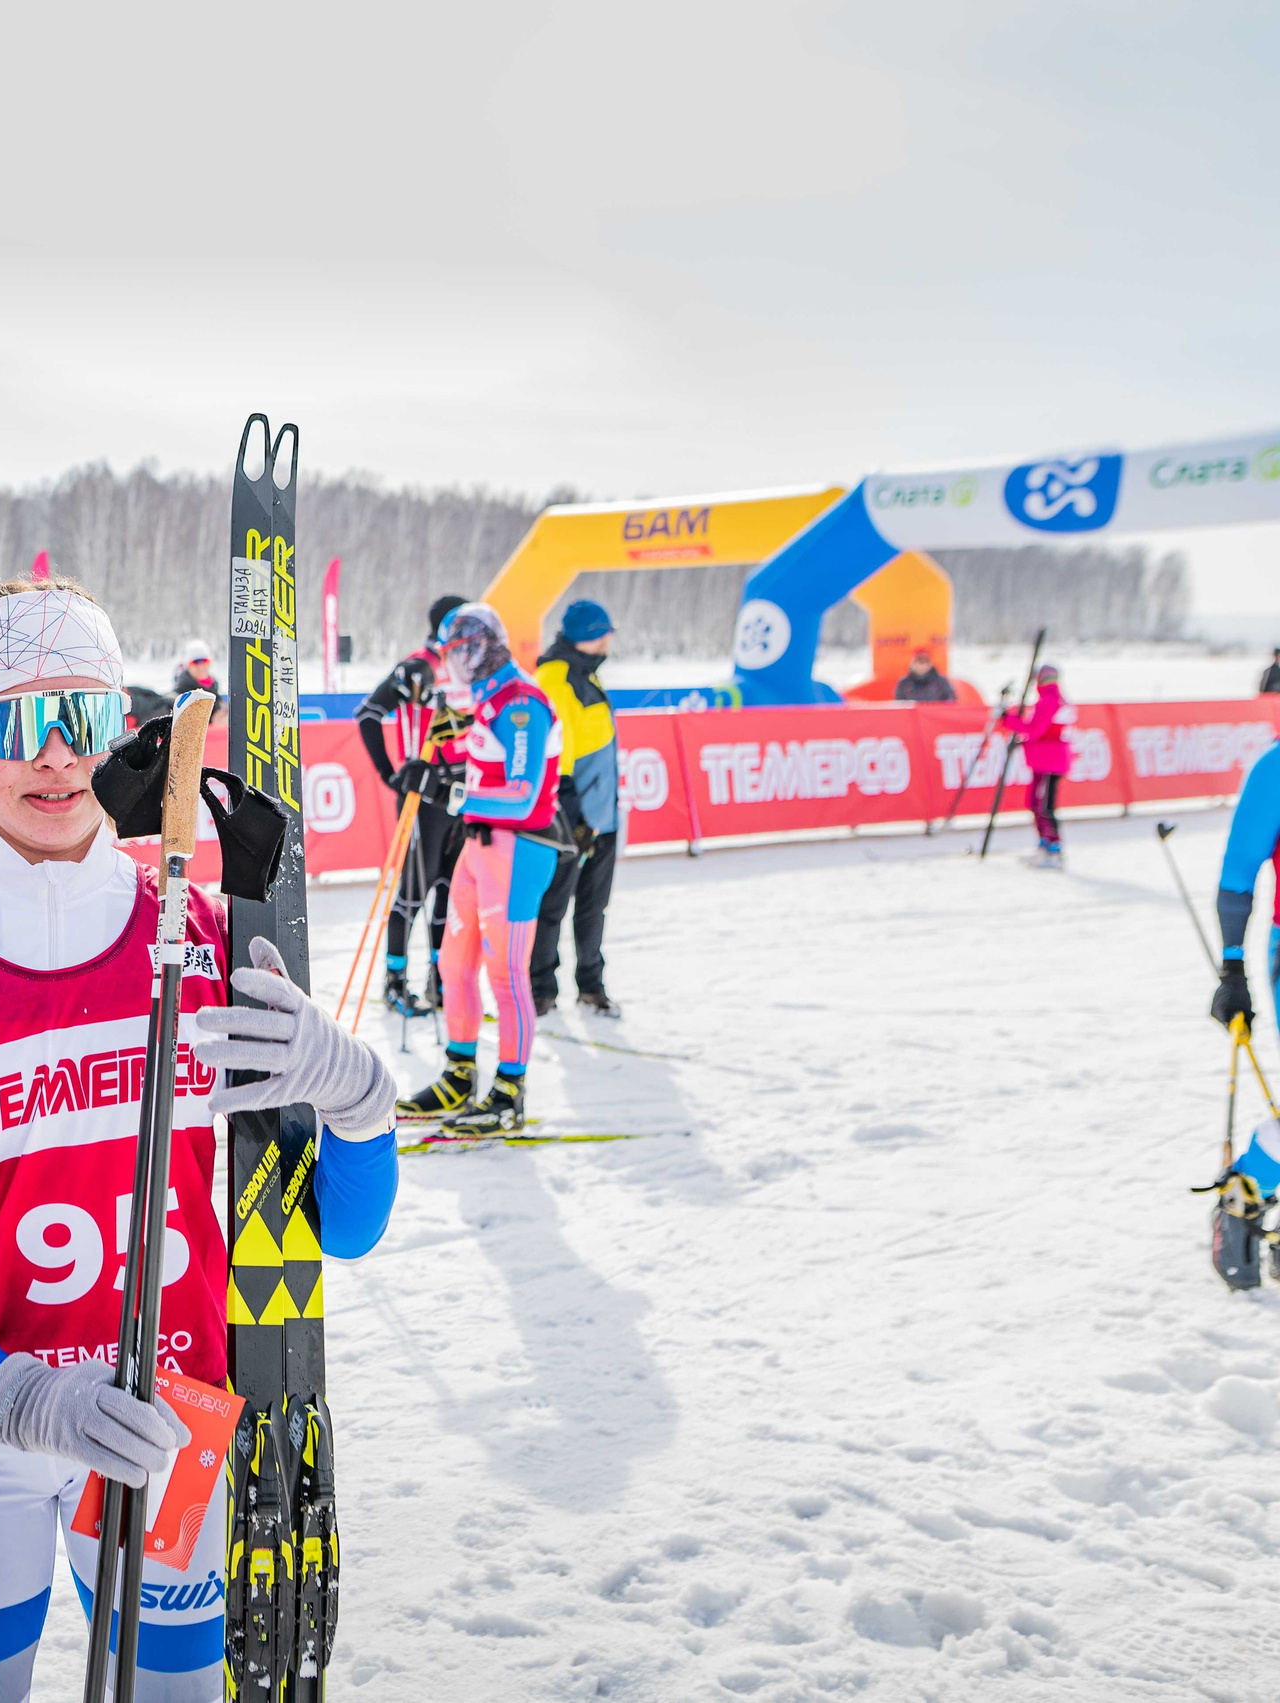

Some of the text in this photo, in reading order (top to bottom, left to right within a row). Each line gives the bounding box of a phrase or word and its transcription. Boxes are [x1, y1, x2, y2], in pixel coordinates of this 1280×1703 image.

[622, 506, 711, 541] БАМ
[236, 1140, 281, 1220] CARBON LITE
[256, 1166, 282, 1210] SKATE COLD
[281, 1160, 308, 1215] CARBON
[15, 1186, 190, 1306] 95
